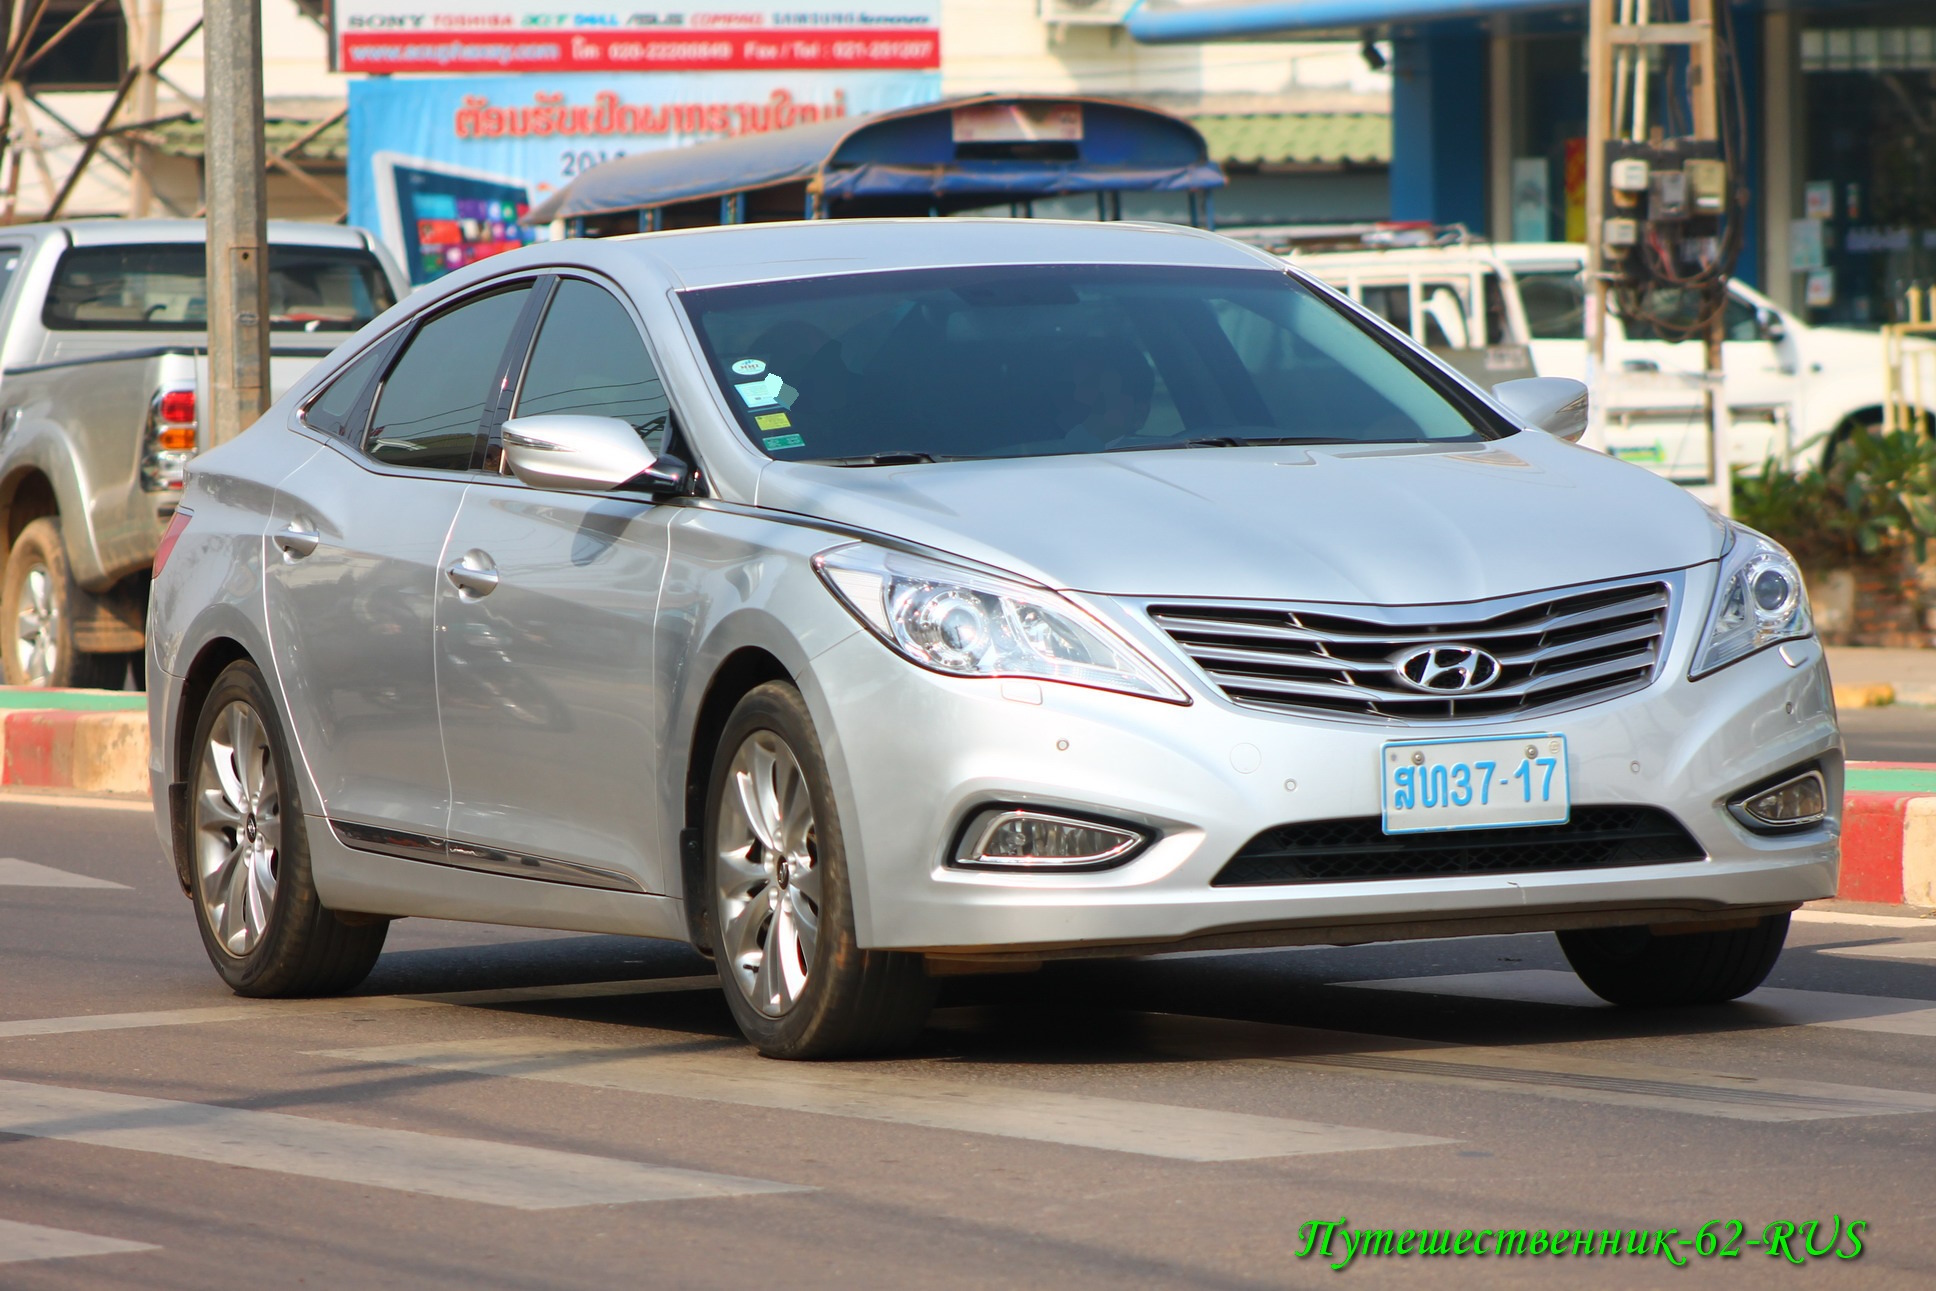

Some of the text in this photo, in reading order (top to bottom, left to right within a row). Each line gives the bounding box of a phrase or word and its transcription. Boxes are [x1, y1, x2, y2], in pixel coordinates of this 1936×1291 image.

[348, 14, 423, 27] SONY
[433, 14, 513, 26] TOSHIBA
[574, 14, 619, 26] DELL
[625, 13, 684, 26] ASUS
[772, 13, 855, 25] SAMSUNG
